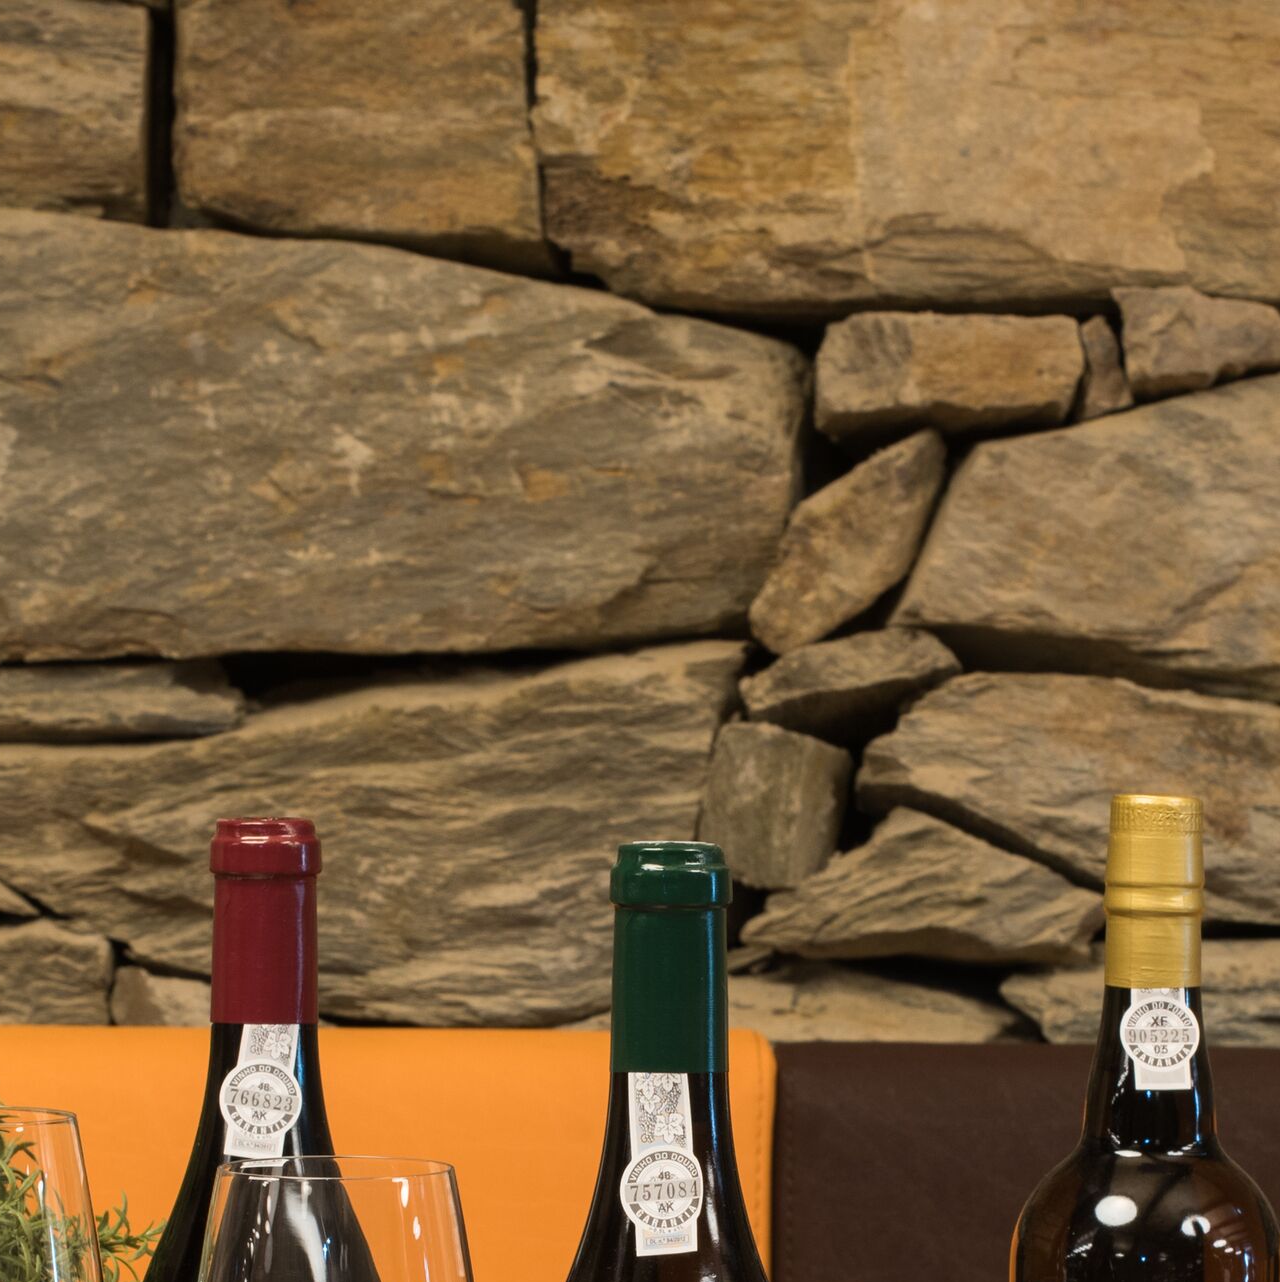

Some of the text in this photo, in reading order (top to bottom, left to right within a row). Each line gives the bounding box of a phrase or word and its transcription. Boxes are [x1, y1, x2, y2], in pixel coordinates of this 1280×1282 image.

[1128, 1029, 1190, 1043] 905225
[232, 1065, 296, 1095] VINHO DO DOURO
[230, 1088, 293, 1112] 766823
[231, 1111, 288, 1134] GARANTIA
[630, 1152, 698, 1181] VINHO DO DOURO
[630, 1180, 699, 1202] 757084
[635, 1205, 697, 1229] GARANTIA
